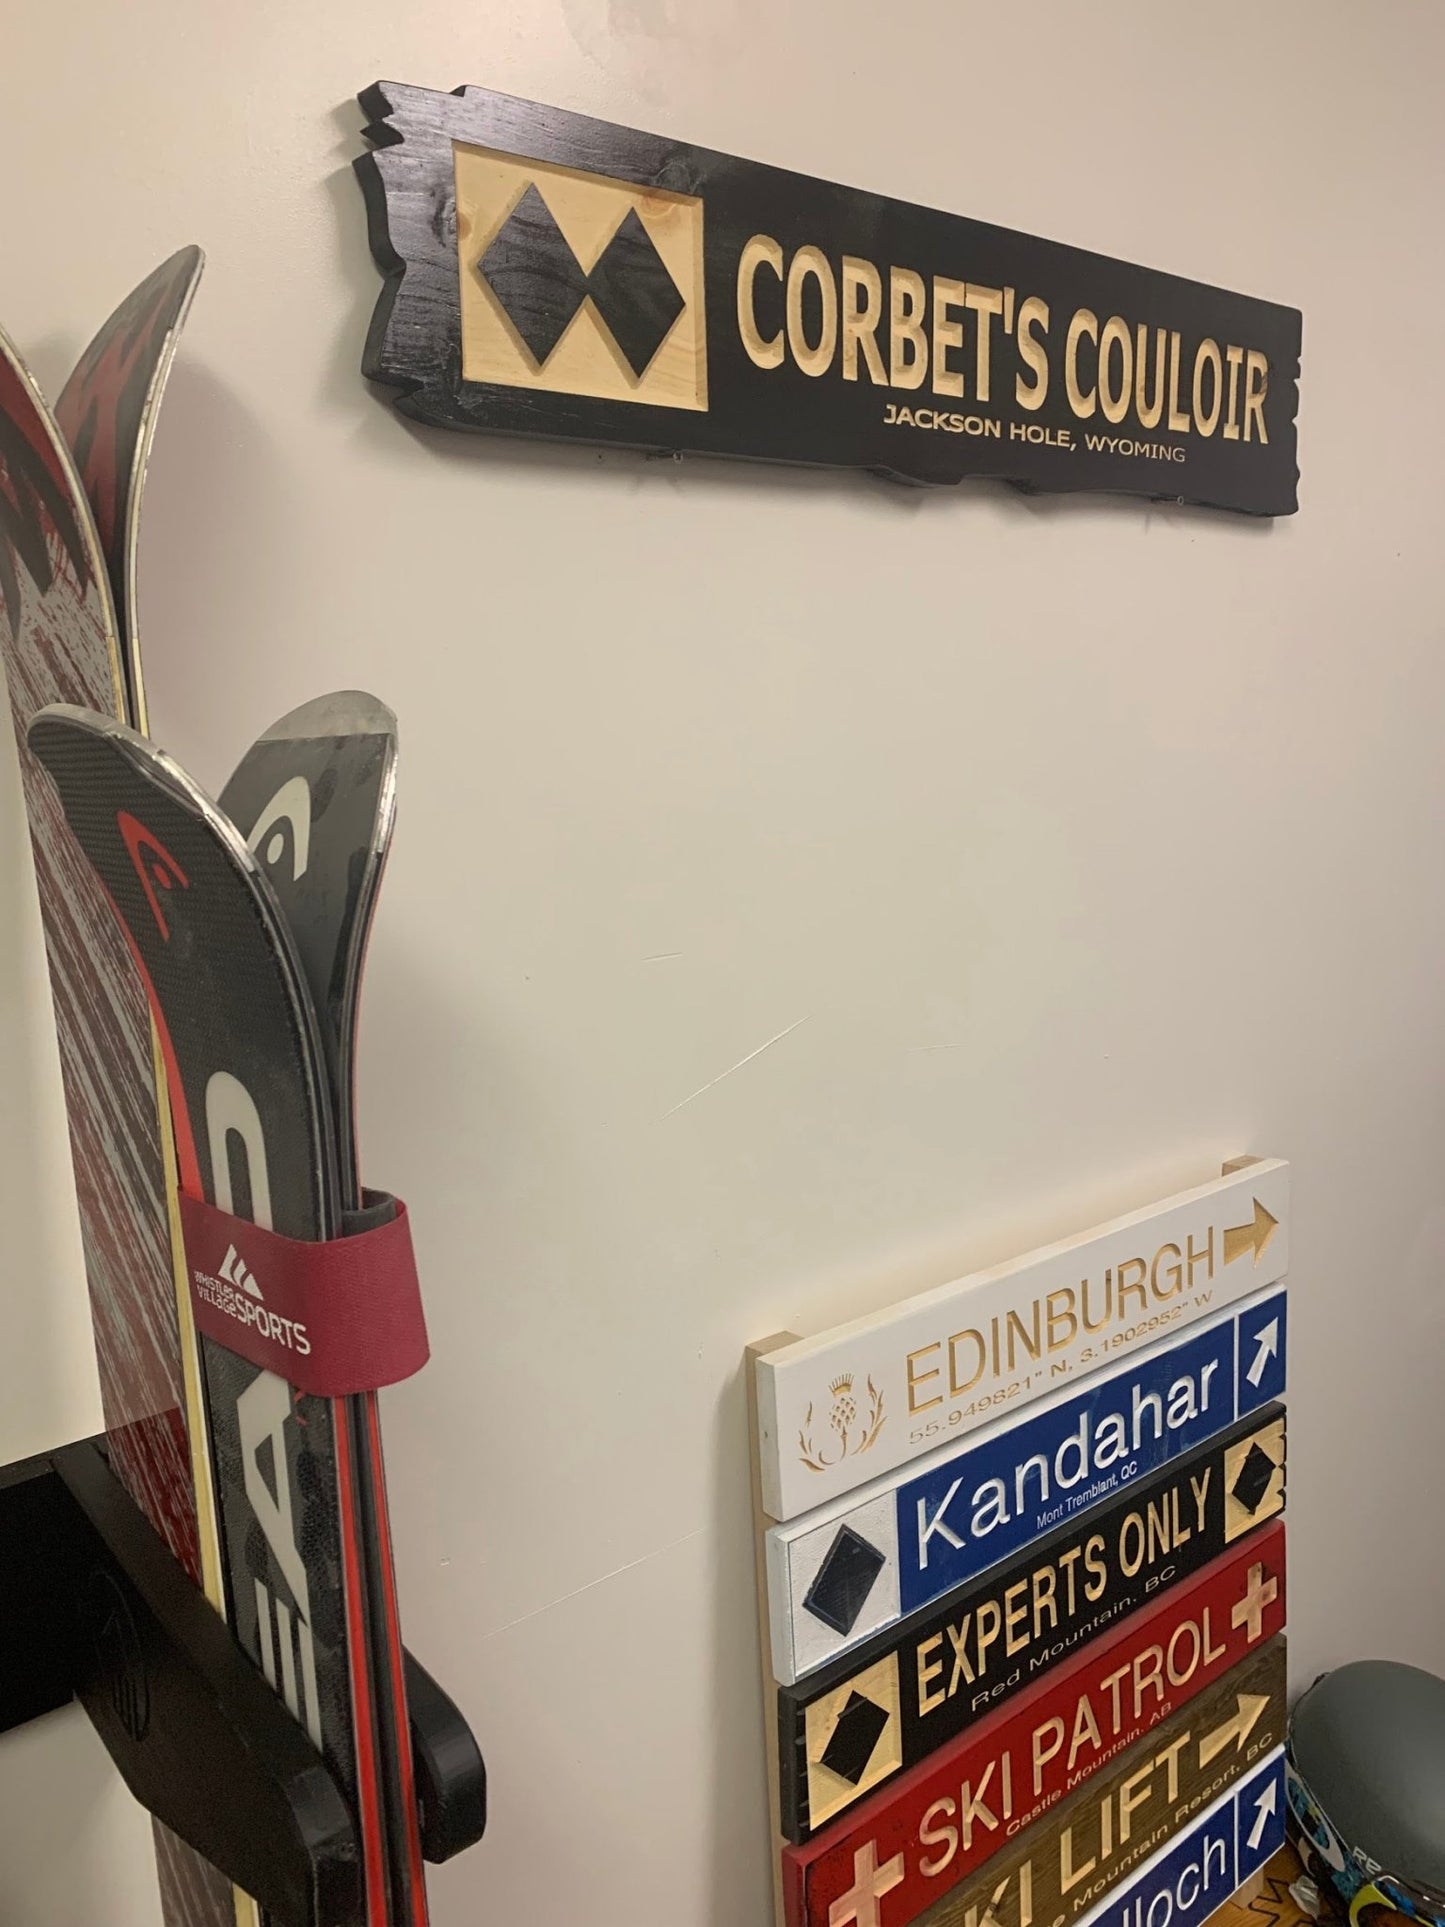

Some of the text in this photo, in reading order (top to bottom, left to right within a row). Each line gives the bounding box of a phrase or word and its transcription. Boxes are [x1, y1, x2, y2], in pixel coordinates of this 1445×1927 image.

[737, 233, 1269, 444] CORBET'S COULOIR
[883, 404, 1186, 462] JACKSON HOLE, WYOMING
[235, 1293, 311, 1355] SPORTS
[907, 1226, 1214, 1417] EDINBURGH
[1194, 1289, 1213, 1308] W
[917, 1358, 1218, 1570] Kandahar
[1037, 1461, 1138, 1530] Mont Tremblant, QC
[917, 1467, 1212, 1717] EXPERTS ONLY
[972, 1668, 1020, 1712] Red
[1145, 1565, 1176, 1593] BC
[918, 1605, 1226, 1878] SKI PATROL
[1006, 1789, 1062, 1836] Castle
[1150, 1702, 1172, 1725] AB
[1060, 1732, 1190, 1895] LIFT
[1073, 1825, 1167, 1912] Mountain
[1247, 1732, 1273, 1761] BC
